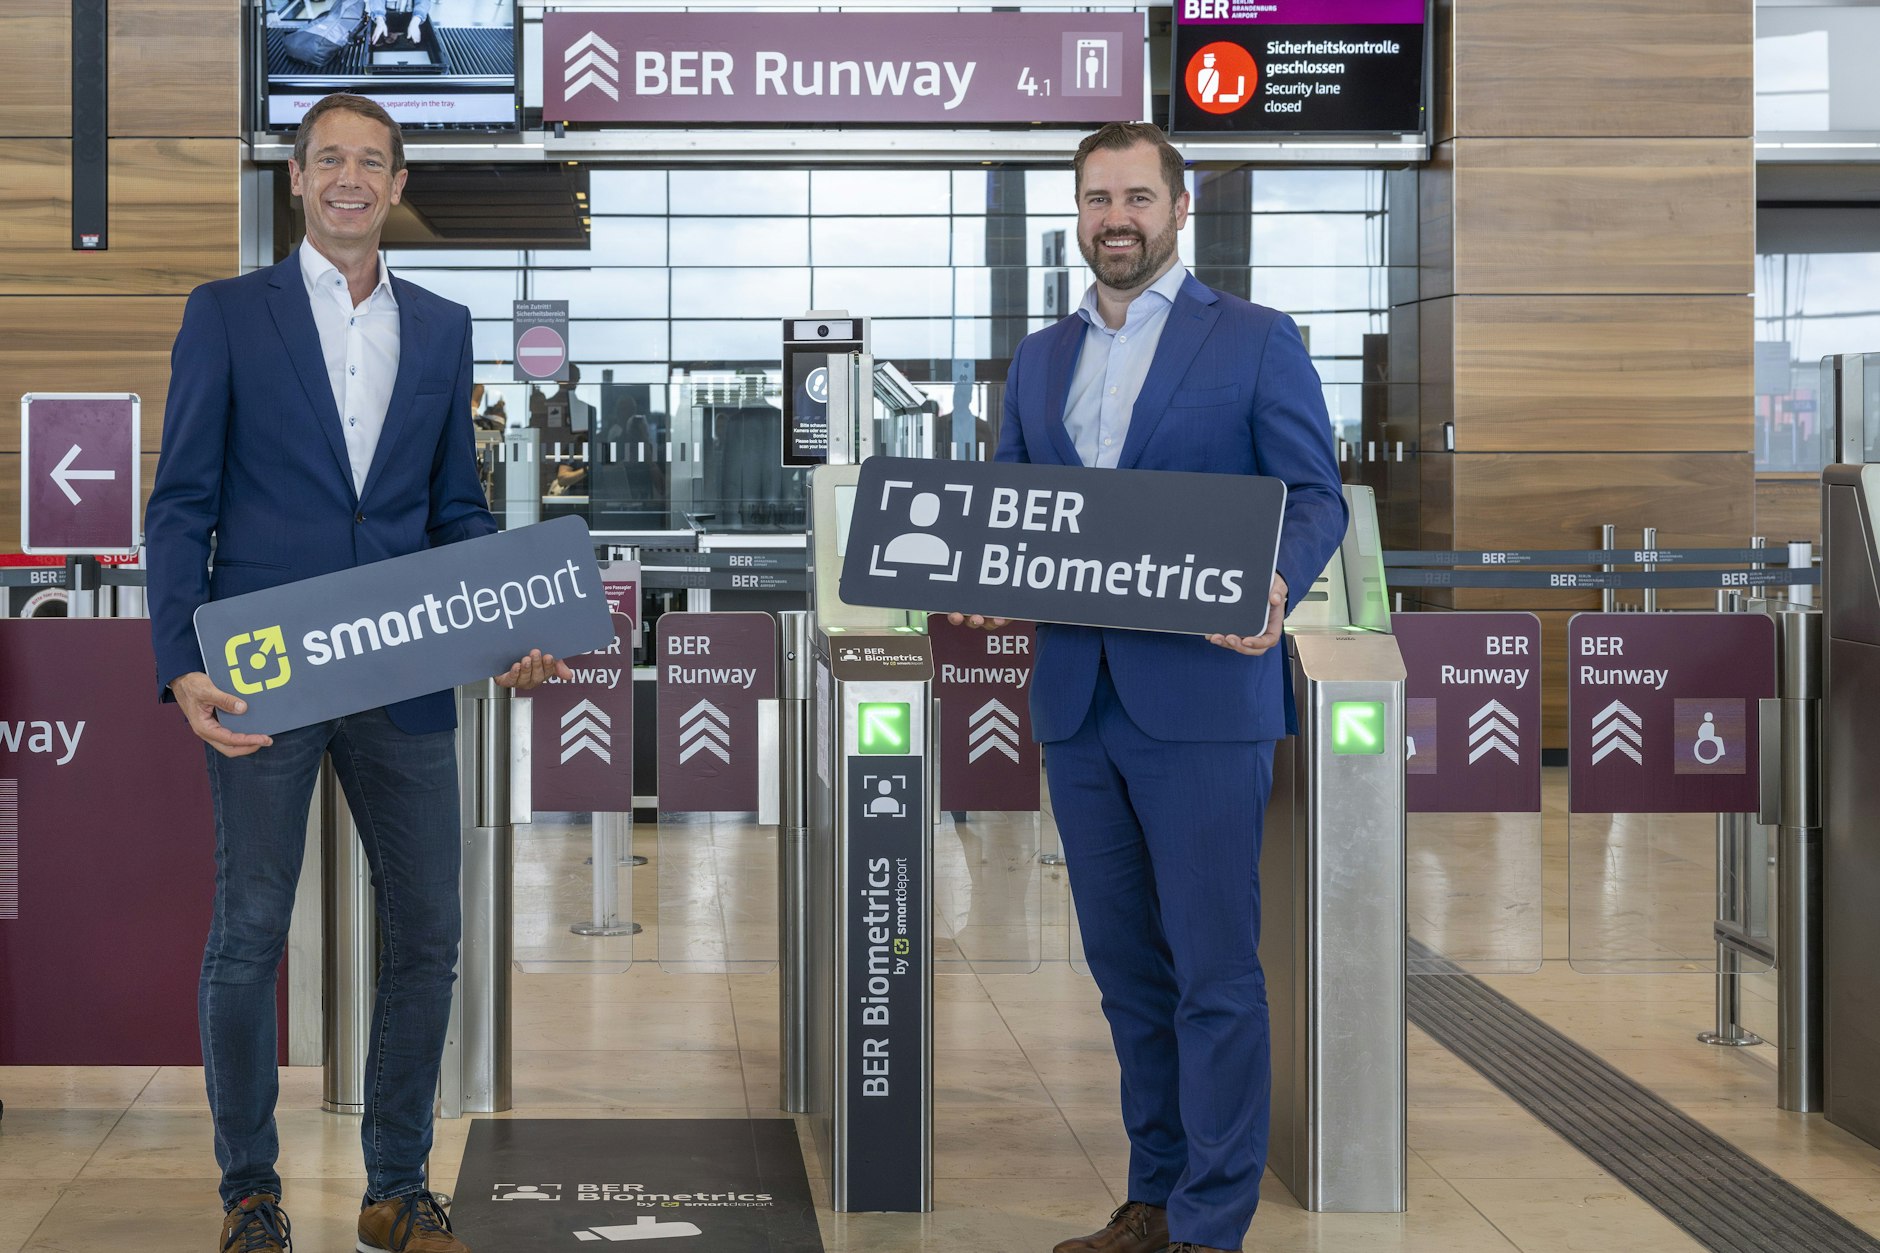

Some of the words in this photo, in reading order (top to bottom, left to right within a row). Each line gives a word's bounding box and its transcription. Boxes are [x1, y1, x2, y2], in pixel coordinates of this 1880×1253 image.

[1184, 0, 1229, 18] BER
[1266, 39, 1400, 55] Sicherheitskontrolle
[1266, 61, 1345, 77] geschlossen
[635, 51, 735, 96] BER
[755, 51, 977, 111] Runway
[1265, 82, 1313, 97] Security
[1315, 82, 1341, 95] lane
[1264, 99, 1302, 113] closed
[987, 486, 1085, 534] BER
[103, 554, 138, 563] STOP
[729, 555, 753, 567] BER
[1482, 553, 1506, 564] BER
[1634, 551, 1658, 563] BER
[30, 571, 57, 584] BER
[732, 574, 759, 588] BER
[978, 542, 1244, 604] Biometrics
[1550, 574, 1577, 587] BER
[1721, 572, 1748, 586] BER
[302, 559, 587, 666] smartdepart
[668, 635, 711, 655] BER
[864, 647, 885, 655] BER
[986, 635, 1029, 655] BER
[1486, 635, 1529, 655] BER
[1581, 636, 1624, 656] BER
[865, 653, 924, 662] Biometrics
[668, 664, 757, 690] Runway
[941, 663, 1030, 689] Runway
[1441, 664, 1530, 690] Runway
[1580, 665, 1669, 690] Runway
[894, 857, 910, 935] smartdepart
[860, 857, 890, 1026] Biometrics
[893, 957, 910, 975] by
[862, 1038, 889, 1097] BER
[577, 1183, 645, 1192] BER
[577, 1191, 773, 1201] Biometrics
[636, 1201, 656, 1209] by
